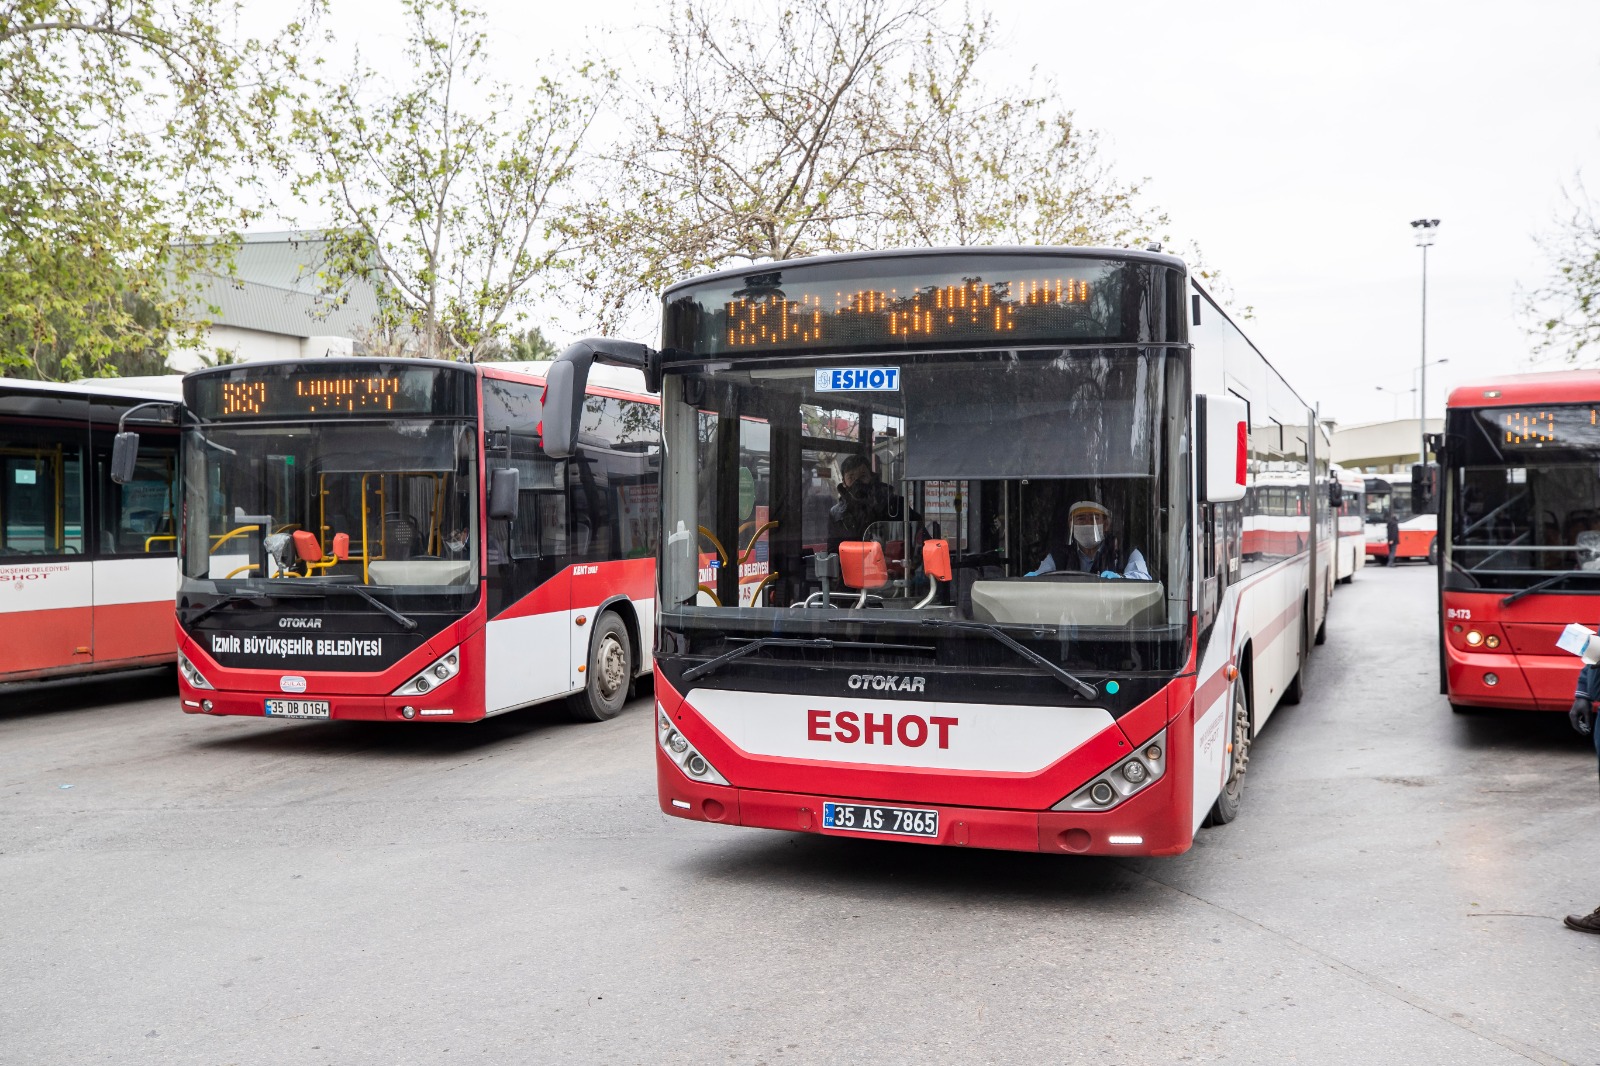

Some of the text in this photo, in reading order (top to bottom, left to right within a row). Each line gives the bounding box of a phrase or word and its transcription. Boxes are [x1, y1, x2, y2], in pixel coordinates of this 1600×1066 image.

[831, 369, 897, 389] ESHOT
[0, 564, 70, 574] ÜKŞEHİR BELEDİYESİ
[573, 565, 587, 576] KENT
[698, 564, 713, 583] ZMİR
[278, 617, 322, 629] OTOKAR
[212, 634, 382, 658] İZMİR BÜYÜKŞEHİR BELEDİYESİ
[847, 674, 926, 692] OTOKAR
[272, 701, 284, 713] 35
[287, 702, 299, 714] DB
[303, 703, 327, 715] 0164
[807, 709, 959, 750] ESHOT
[834, 806, 855, 827] 35
[862, 808, 883, 829] AS
[892, 810, 936, 833] 7865
